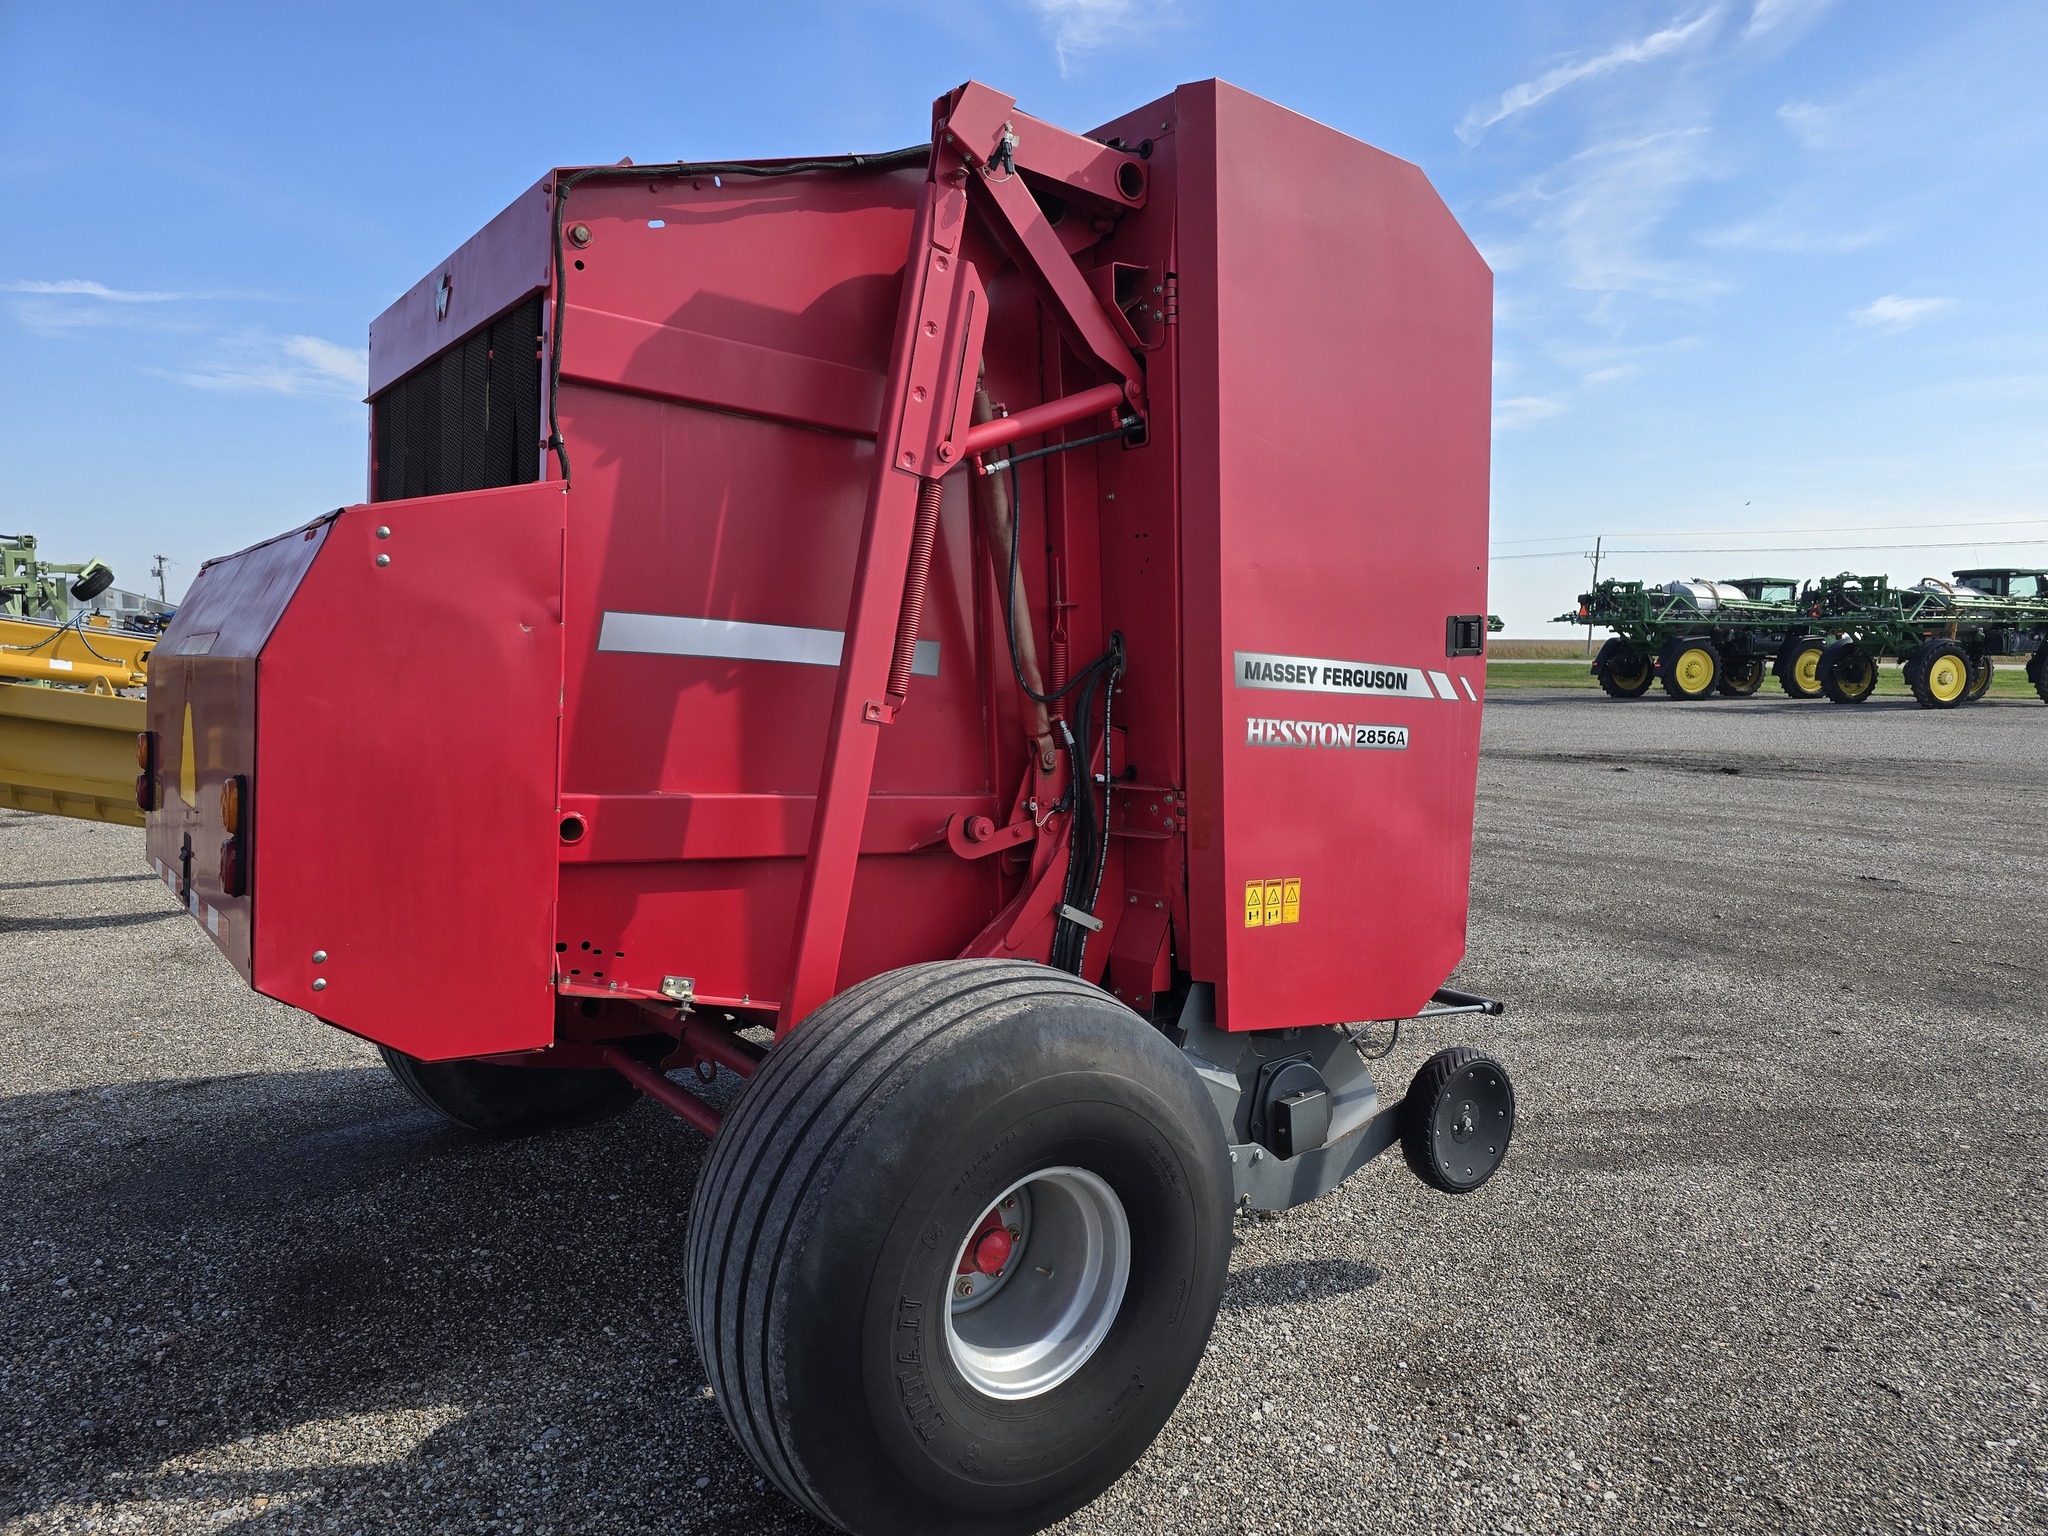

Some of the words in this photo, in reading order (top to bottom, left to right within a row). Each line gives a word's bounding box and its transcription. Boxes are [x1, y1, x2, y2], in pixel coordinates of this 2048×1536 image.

[1244, 660, 1318, 685] MASSEY
[1322, 666, 1408, 691] FERGUSON
[1246, 717, 1354, 750] HESSTON
[1356, 729, 1406, 746] 2856A
[897, 1294, 946, 1446] TITAN
